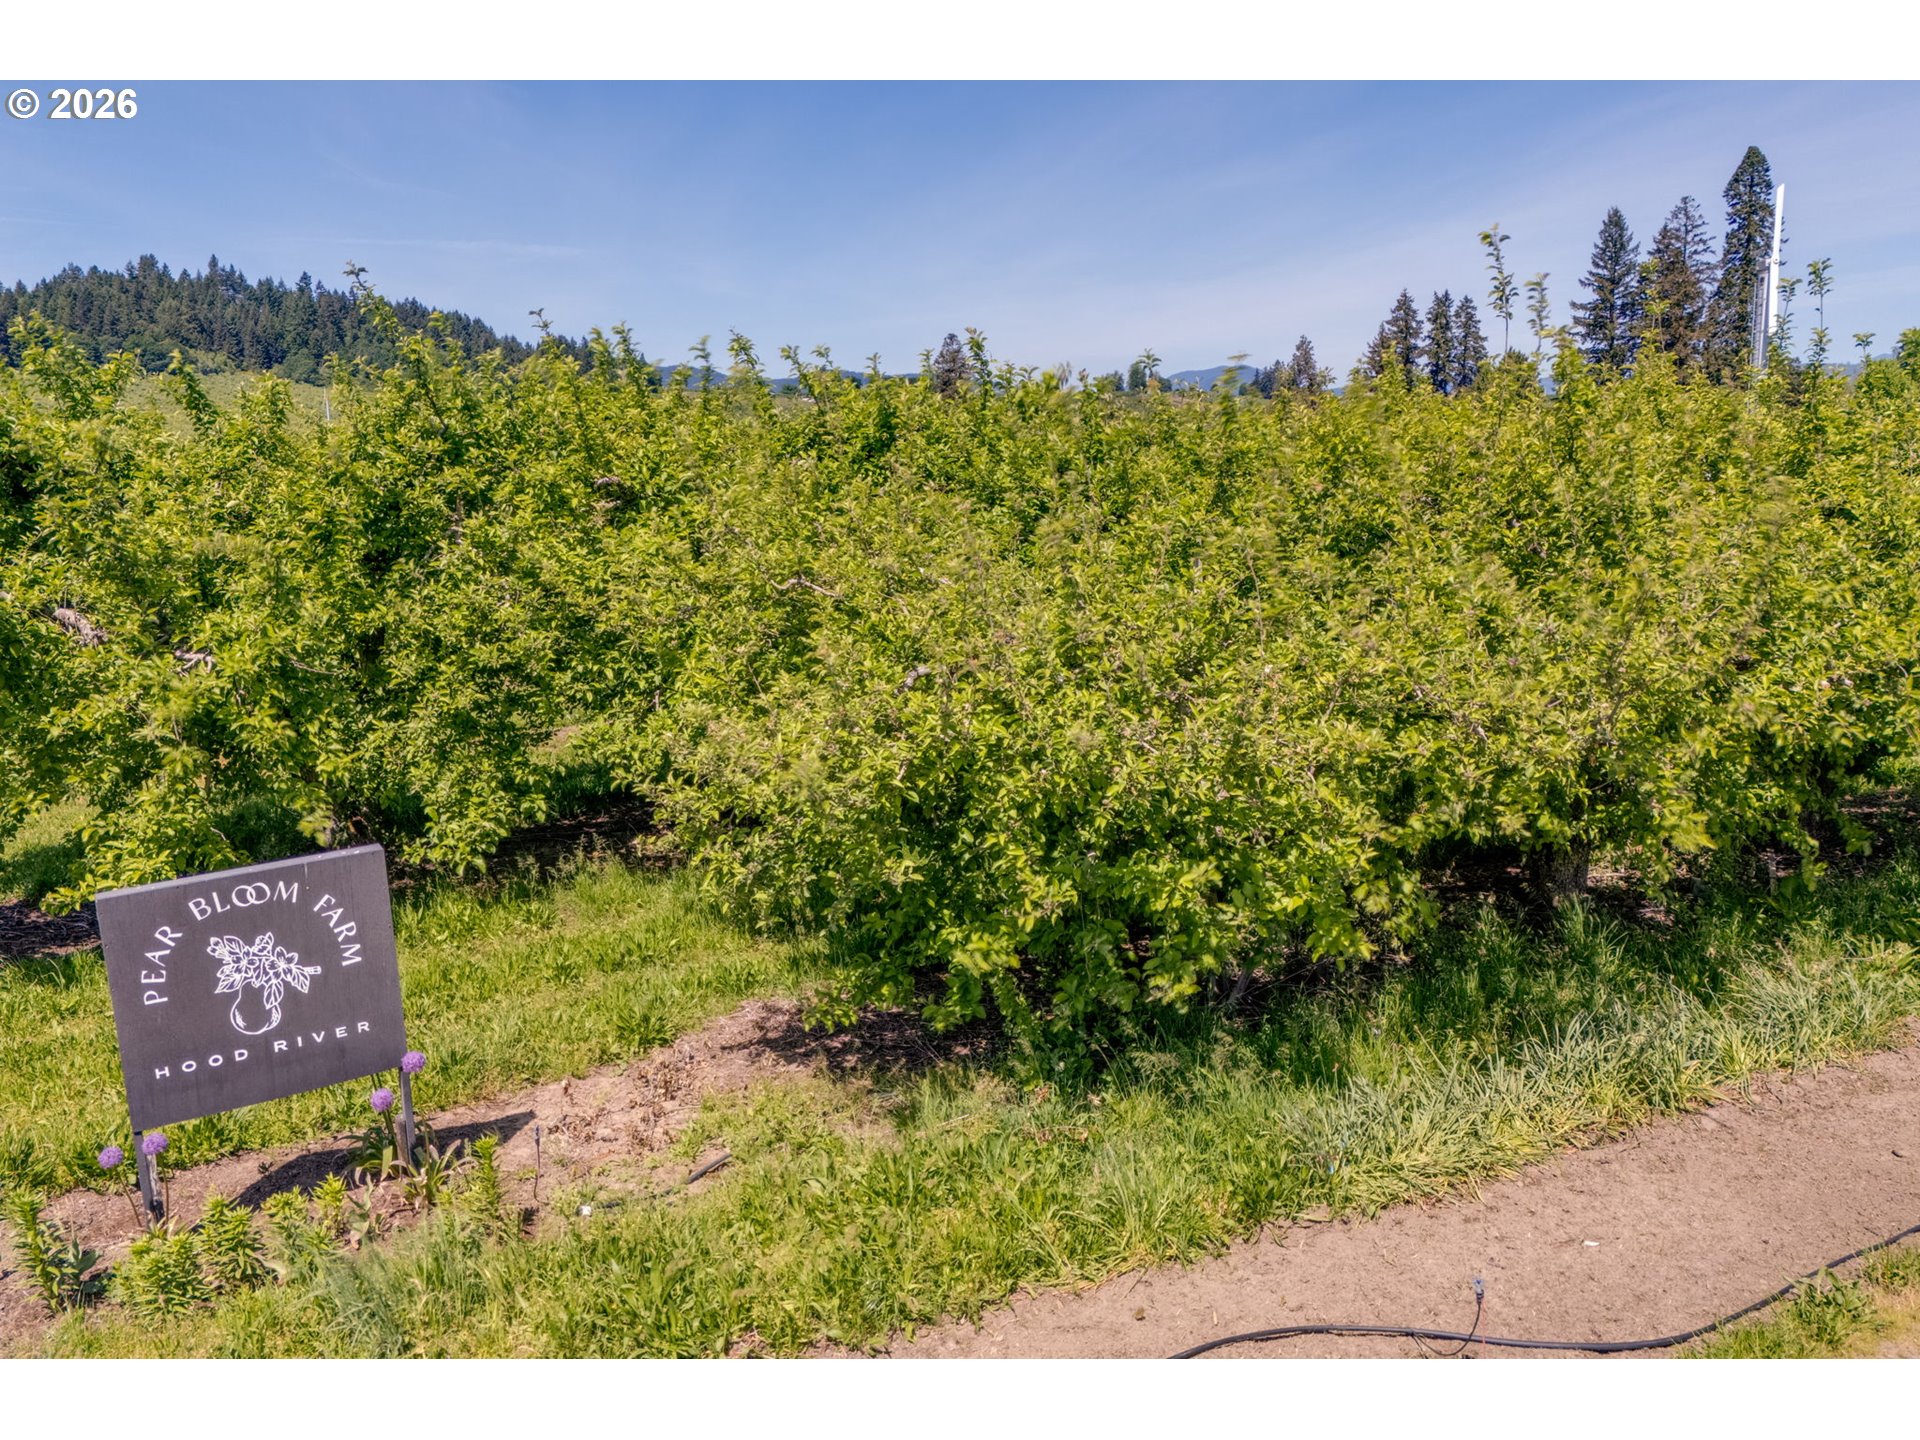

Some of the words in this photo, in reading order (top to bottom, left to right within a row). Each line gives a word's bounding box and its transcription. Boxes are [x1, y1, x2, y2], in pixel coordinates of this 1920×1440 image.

[140, 925, 183, 1006] PEAR
[188, 880, 299, 921] BLOOM
[312, 894, 362, 967] FARM
[154, 1049, 249, 1080] HOOD
[273, 1021, 371, 1052] RIVER
